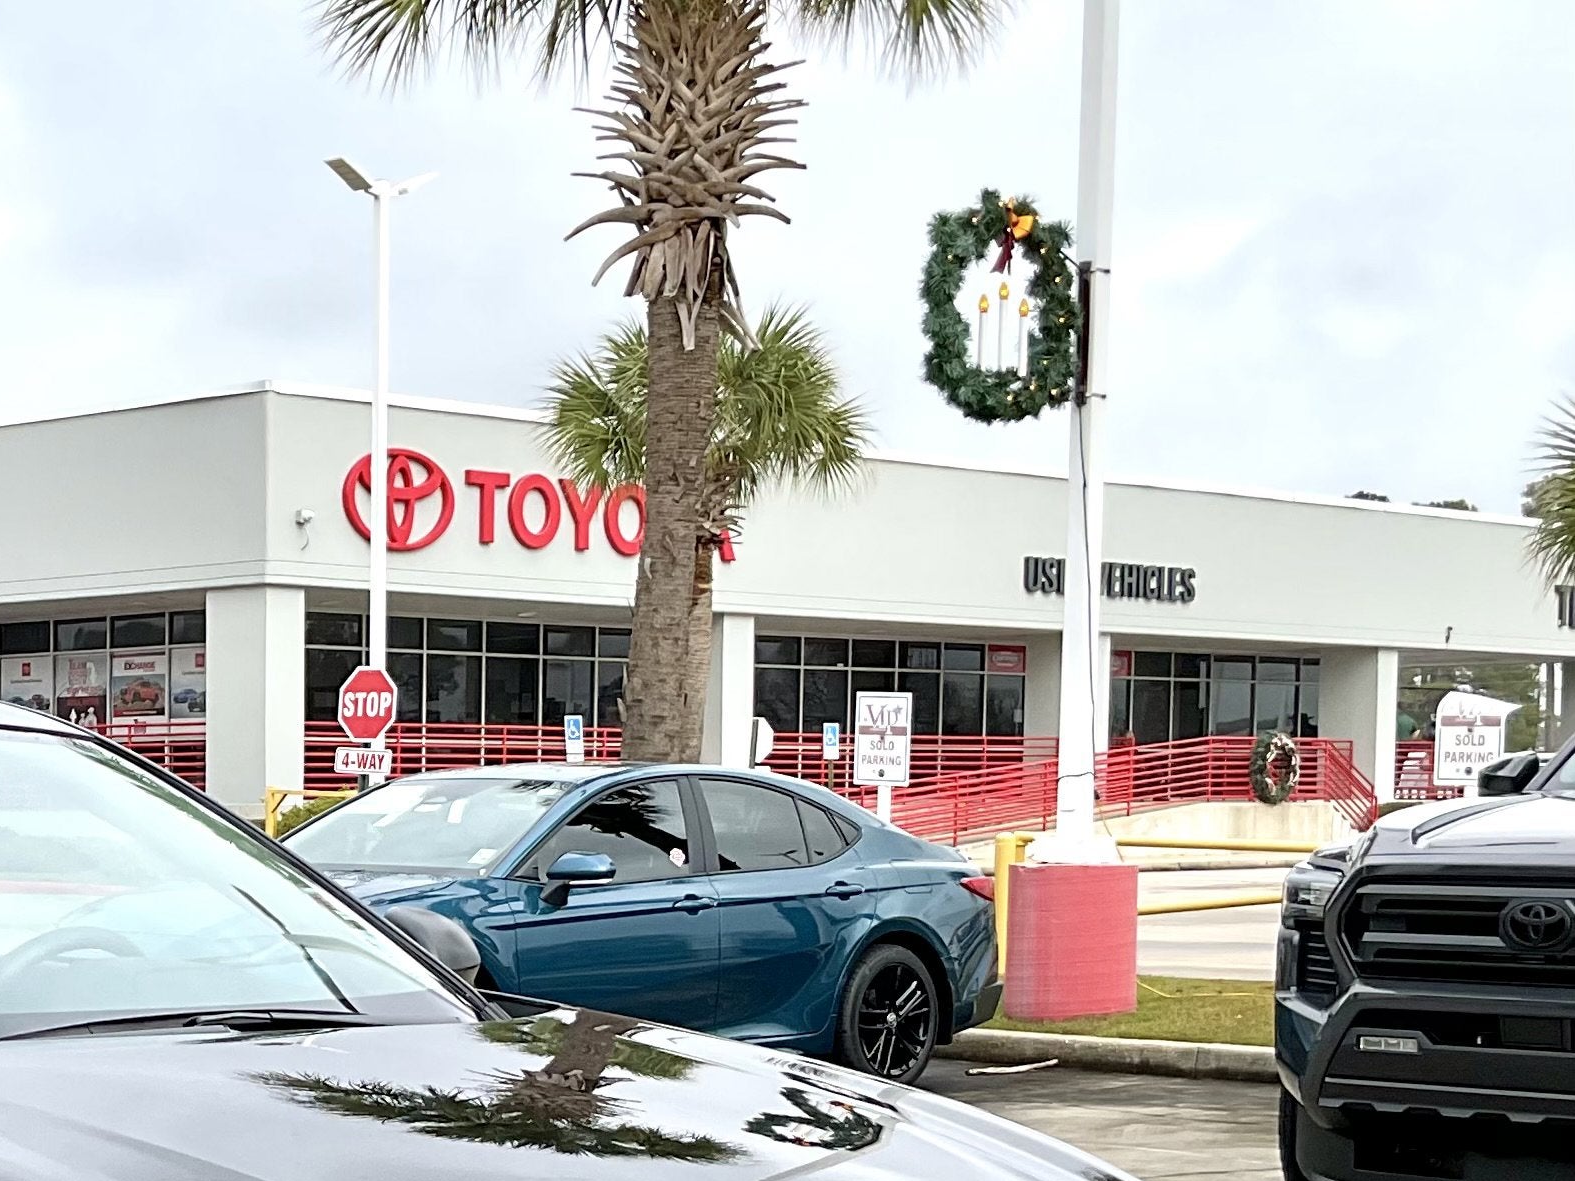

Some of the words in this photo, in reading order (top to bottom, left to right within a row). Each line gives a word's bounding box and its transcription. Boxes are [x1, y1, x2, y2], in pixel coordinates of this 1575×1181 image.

[464, 469, 737, 562] TOYO
[1024, 556, 1066, 594] US
[343, 691, 392, 718] STOP
[870, 740, 895, 751] SOLD
[1455, 734, 1485, 746] SOLD
[341, 752, 385, 770] 4-WAY
[861, 754, 902, 766] PARKING
[1444, 751, 1494, 763] PARKING
